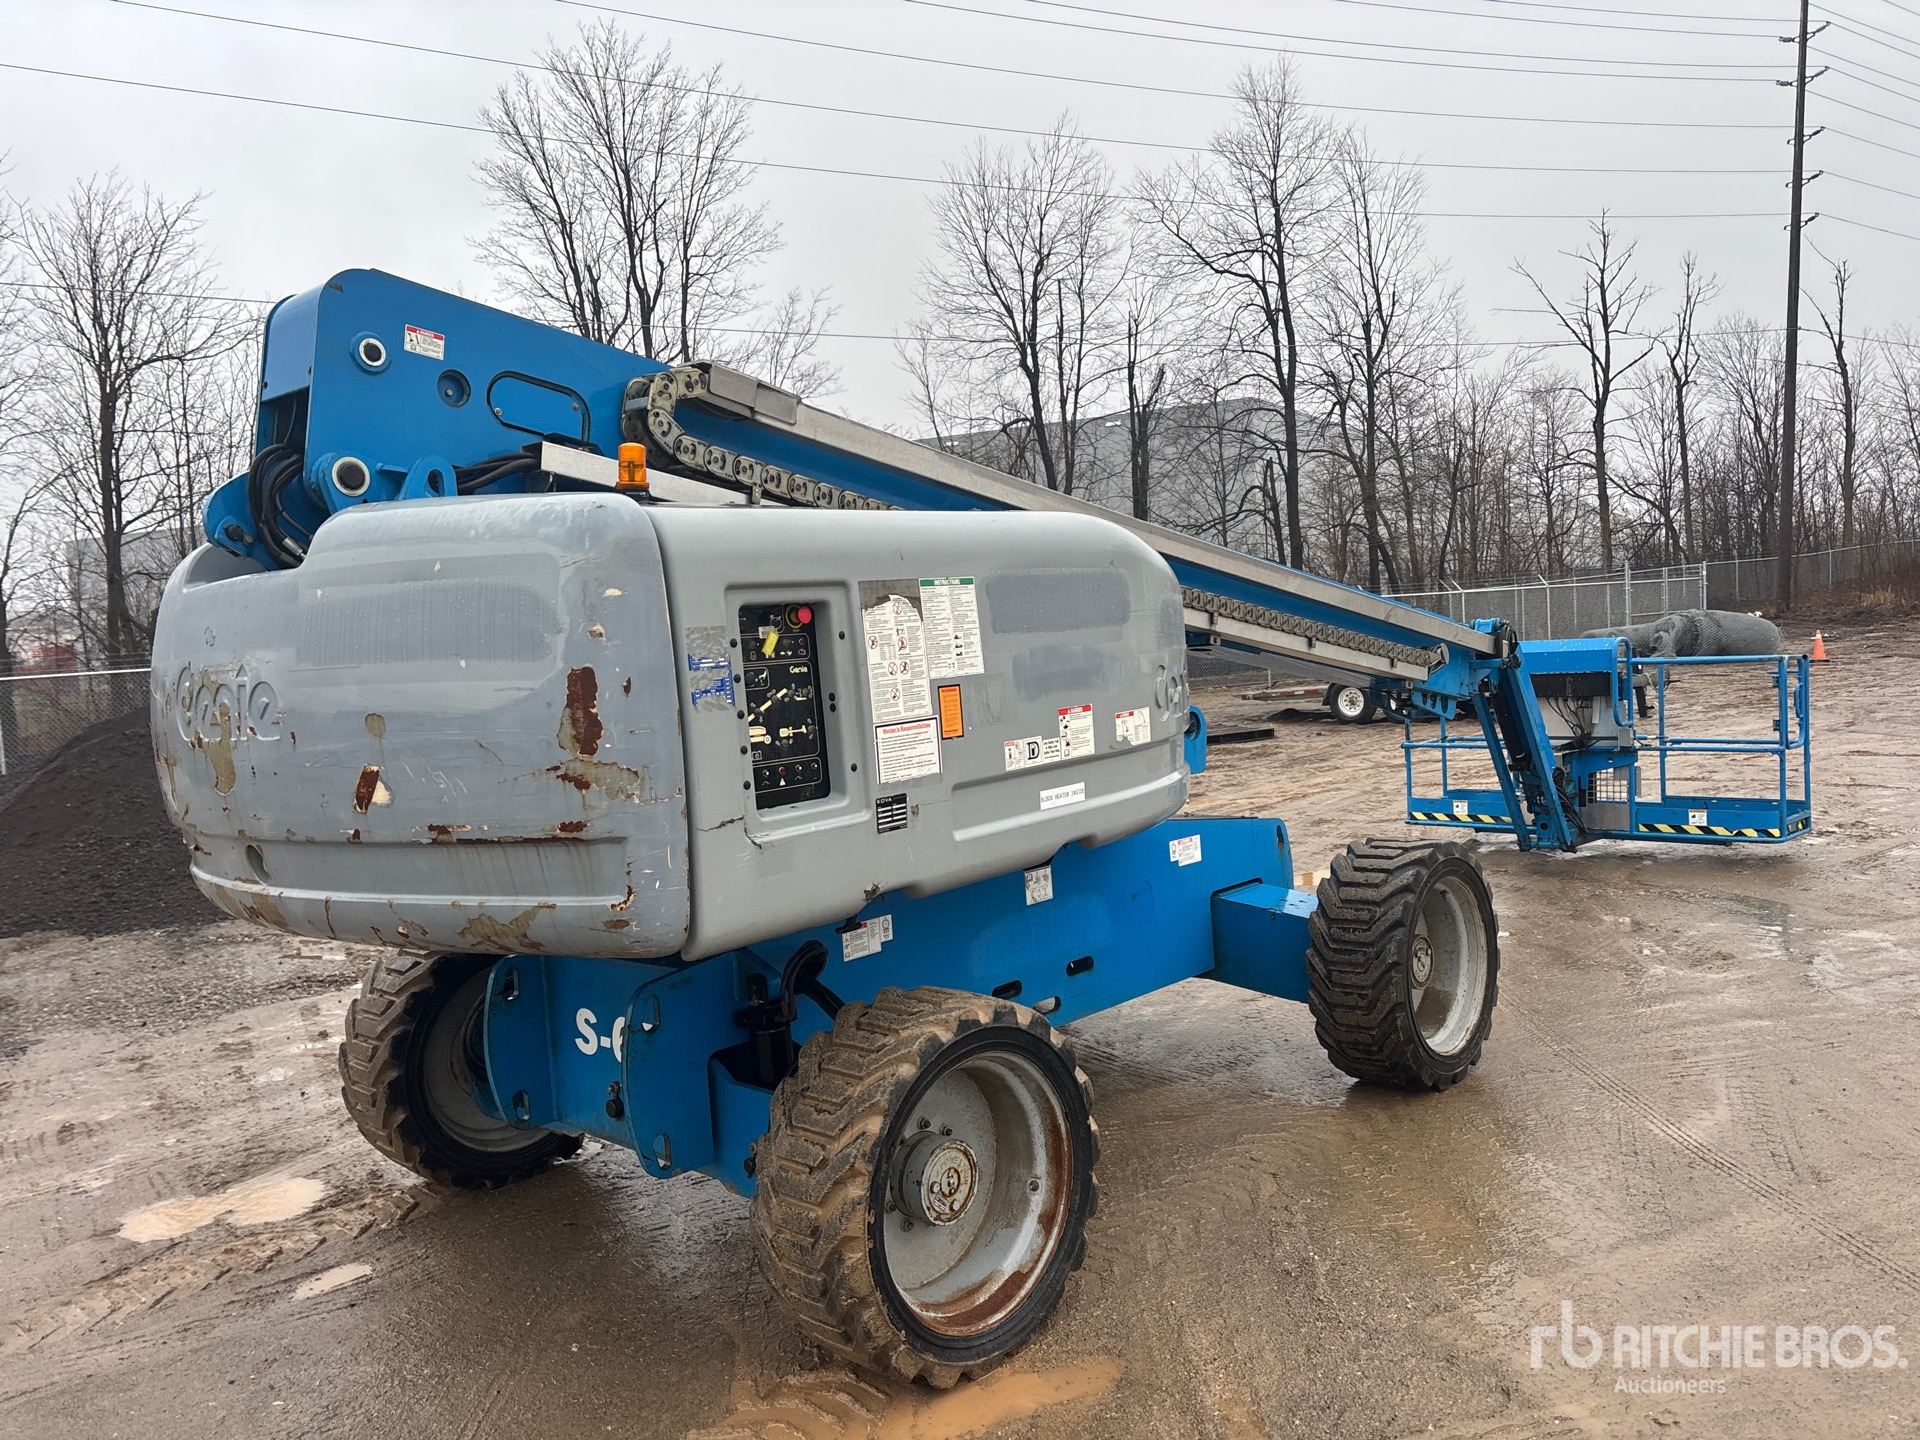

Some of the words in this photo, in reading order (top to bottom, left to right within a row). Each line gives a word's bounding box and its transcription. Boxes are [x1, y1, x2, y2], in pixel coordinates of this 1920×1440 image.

[789, 665, 809, 674] Genie
[1054, 791, 1070, 800] HEATER
[1071, 788, 1085, 796] INSIDE
